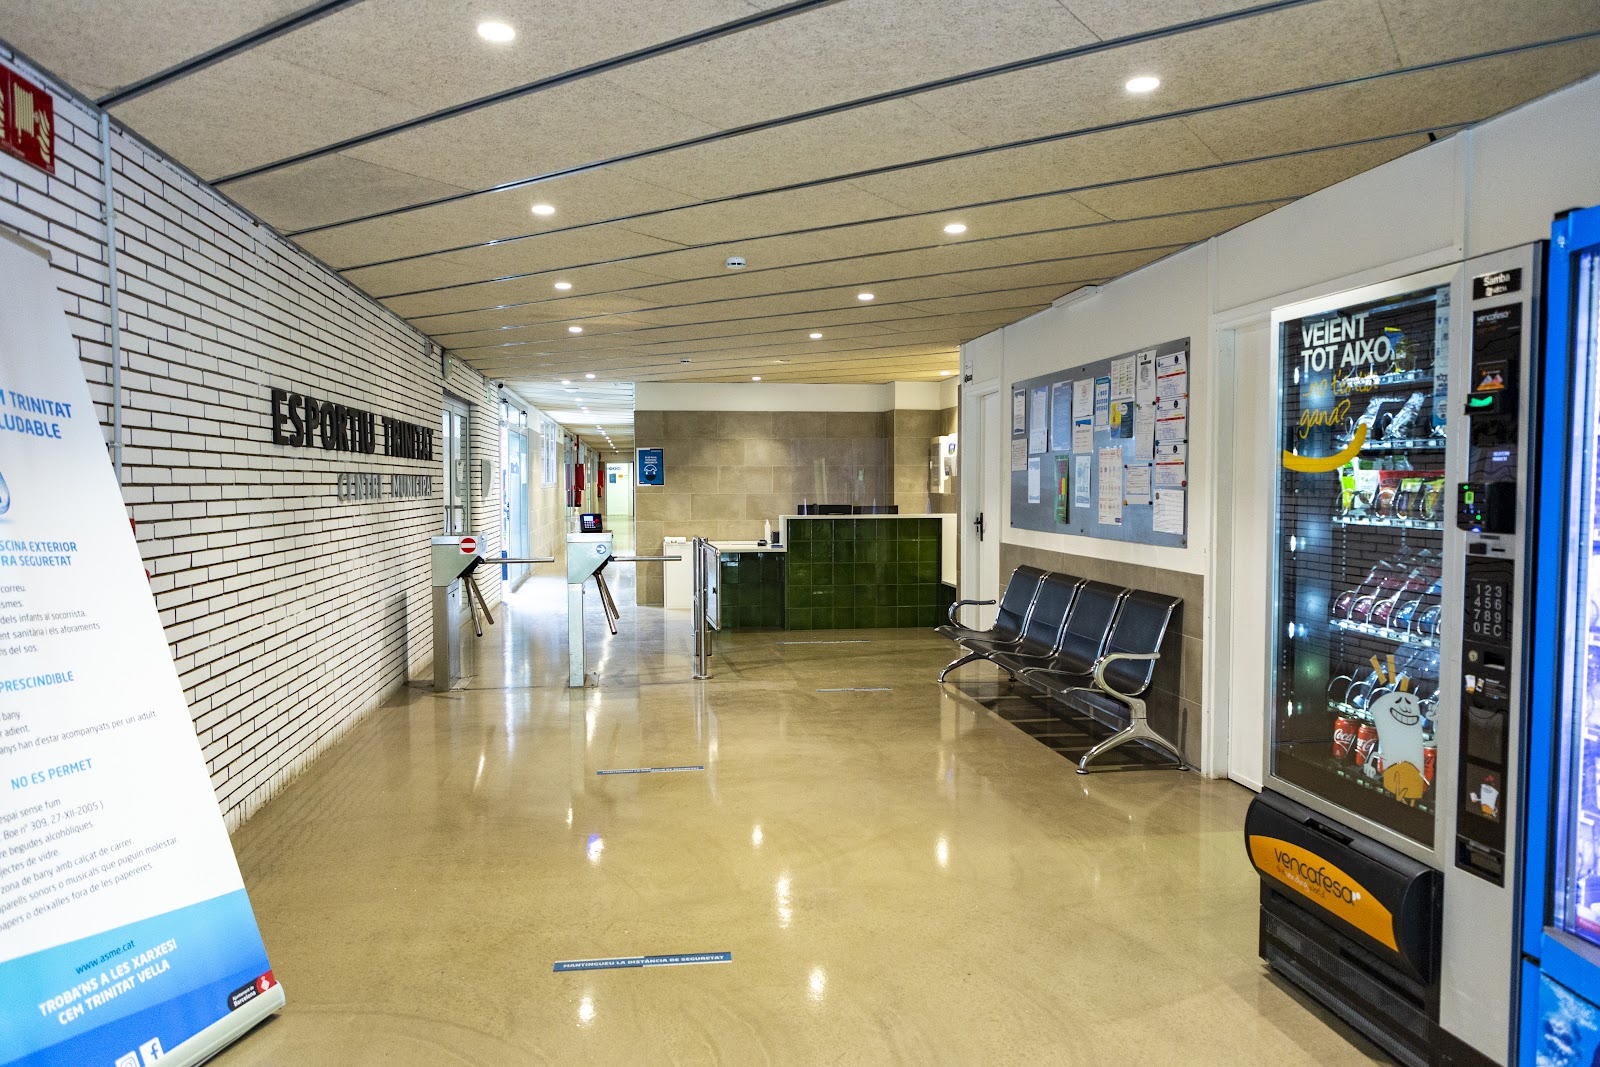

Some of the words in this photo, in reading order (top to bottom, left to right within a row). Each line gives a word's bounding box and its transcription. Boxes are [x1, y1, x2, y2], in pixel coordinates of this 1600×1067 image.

[1483, 273, 1510, 287] Samba
[1302, 312, 1369, 348] VEIENT
[1301, 345, 1339, 373] TOT
[9, 391, 72, 418] TRINITAT
[271, 388, 376, 454] ESPORTIU
[382, 415, 434, 461] TRINITAT
[1300, 399, 1351, 439] gana?
[338, 474, 384, 503] CENTRE
[29, 541, 78, 552] EXTERIOR
[19, 555, 72, 567] SEGURETAT
[1476, 584, 1480, 595] 1
[1484, 585, 1491, 596] 2
[1495, 586, 1502, 597] 3
[0, 600, 24, 609] smes.
[1474, 597, 1481, 607] 4
[1485, 597, 1491, 609] 5
[1495, 599, 1502, 610] 6
[0, 614, 18, 625] dels
[19, 612, 43, 623] infants
[44, 611, 50, 621] al
[51, 609, 88, 621] socorrista.
[1473, 609, 1480, 620] 7
[1484, 610, 1491, 622] 8
[1494, 612, 1501, 623] 9
[48, 626, 59, 636] els
[60, 621, 101, 634] aforaments
[1483, 622, 1491, 635] E
[1493, 624, 1502, 637] C
[9, 644, 22, 655] del
[0, 670, 75, 693] PRESCINDIBLE
[5, 724, 31, 737] adient.
[18, 739, 33, 750] han
[35, 734, 60, 747] d'estar
[61, 721, 111, 741] acompanyats
[112, 718, 124, 729] per
[126, 716, 136, 725] un
[137, 710, 159, 721] adult.
[11, 775, 29, 791] NO
[31, 770, 46, 785] ES
[48, 758, 93, 780] PERMET
[20, 803, 43, 818] sense
[45, 797, 61, 809] fum
[4, 828, 19, 840] Boe
[52, 801, 99, 824] 27-XII-2005
[9, 837, 44, 856] begudes
[26, 856, 37, 867] de
[38, 848, 61, 862] vidre.
[1, 880, 21, 895] zona
[21, 875, 32, 886] de
[33, 867, 54, 882] bany
[55, 858, 73, 873] amb
[74, 851, 98, 867] calçat
[98, 846, 109, 857] de
[110, 838, 135, 852] carrer.
[29, 883, 57, 901] sonors
[58, 880, 64, 889] o
[66, 864, 100, 886] musicals
[101, 860, 116, 874] que
[117, 849, 145, 867] puguin
[145, 836, 177, 855] molestar
[1274, 848, 1354, 906] vencafesa
[26, 910, 32, 921] o
[33, 896, 71, 917] deixalles
[71, 889, 88, 902] fora
[89, 883, 100, 894] de
[100, 878, 114, 889] les
[114, 862, 153, 885] papereres
[75, 940, 135, 975] www.asme.cat
[563, 960, 615, 968] MANTINGUEU
[680, 955, 725, 963] SEGURETAT
[39, 977, 99, 1017] TROBA'NS
[100, 972, 110, 986] A
[109, 961, 131, 980] LES
[131, 938, 178, 969] XARXES!
[58, 1002, 85, 1025] CEM
[85, 975, 136, 1011] TRINITAT
[136, 959, 171, 983] VELLA
[233, 990, 257, 1007] Barcelona
